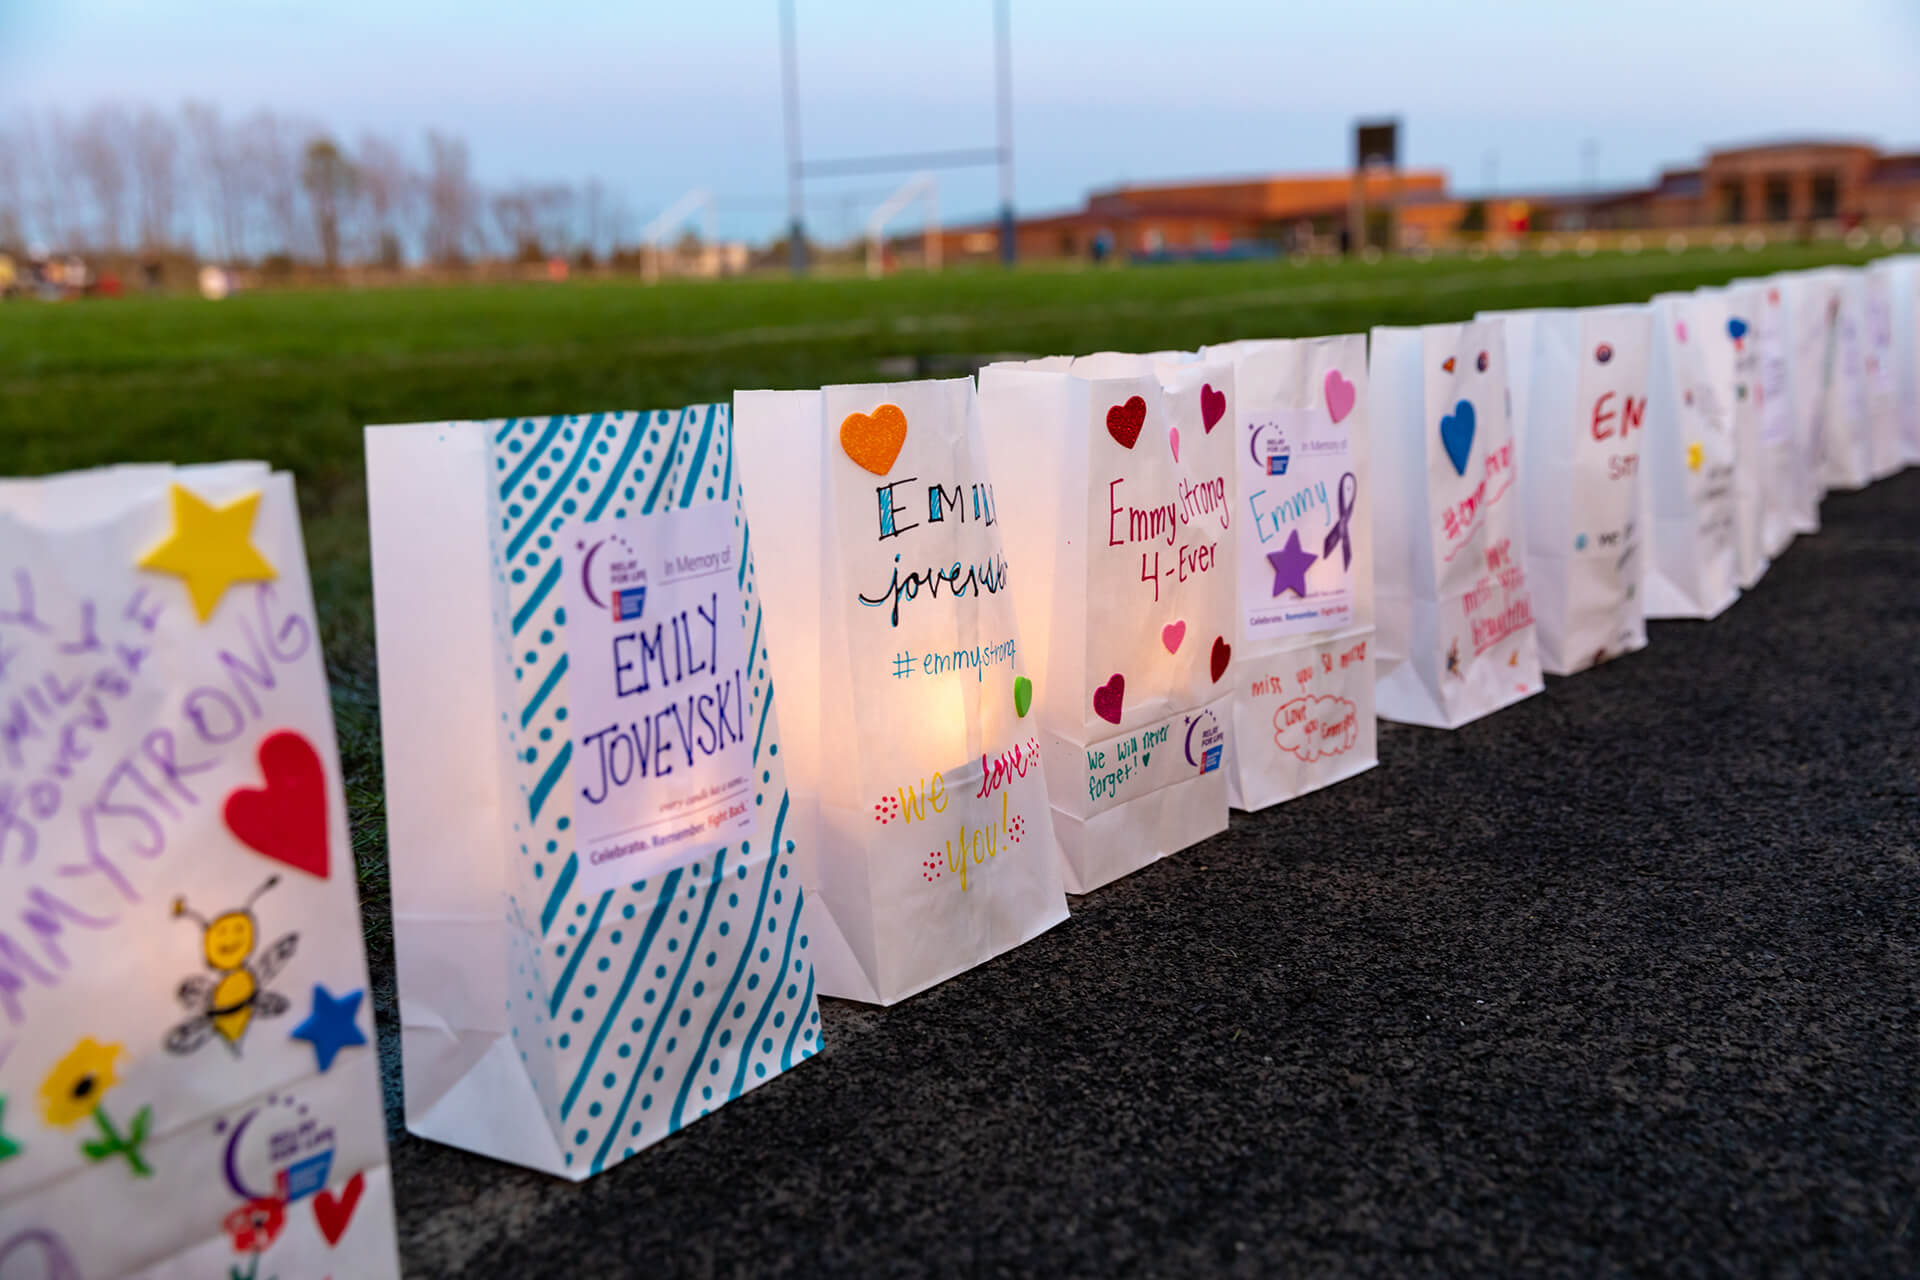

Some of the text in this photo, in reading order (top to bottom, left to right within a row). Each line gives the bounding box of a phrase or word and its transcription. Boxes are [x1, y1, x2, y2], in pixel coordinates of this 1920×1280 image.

[1248, 480, 1332, 544] Emmy
[612, 592, 718, 698] EMILY
[892, 639, 1016, 682] #emmystrong
[1251, 673, 1282, 697] miss
[580, 669, 744, 805] JOVEVSKI
[1142, 724, 1170, 751] never
[976, 743, 1028, 799] love
[1088, 756, 1139, 801] forget!
[589, 839, 649, 866] Celebrate.
[708, 811, 728, 829] Fight
[946, 792, 1009, 891] you!
